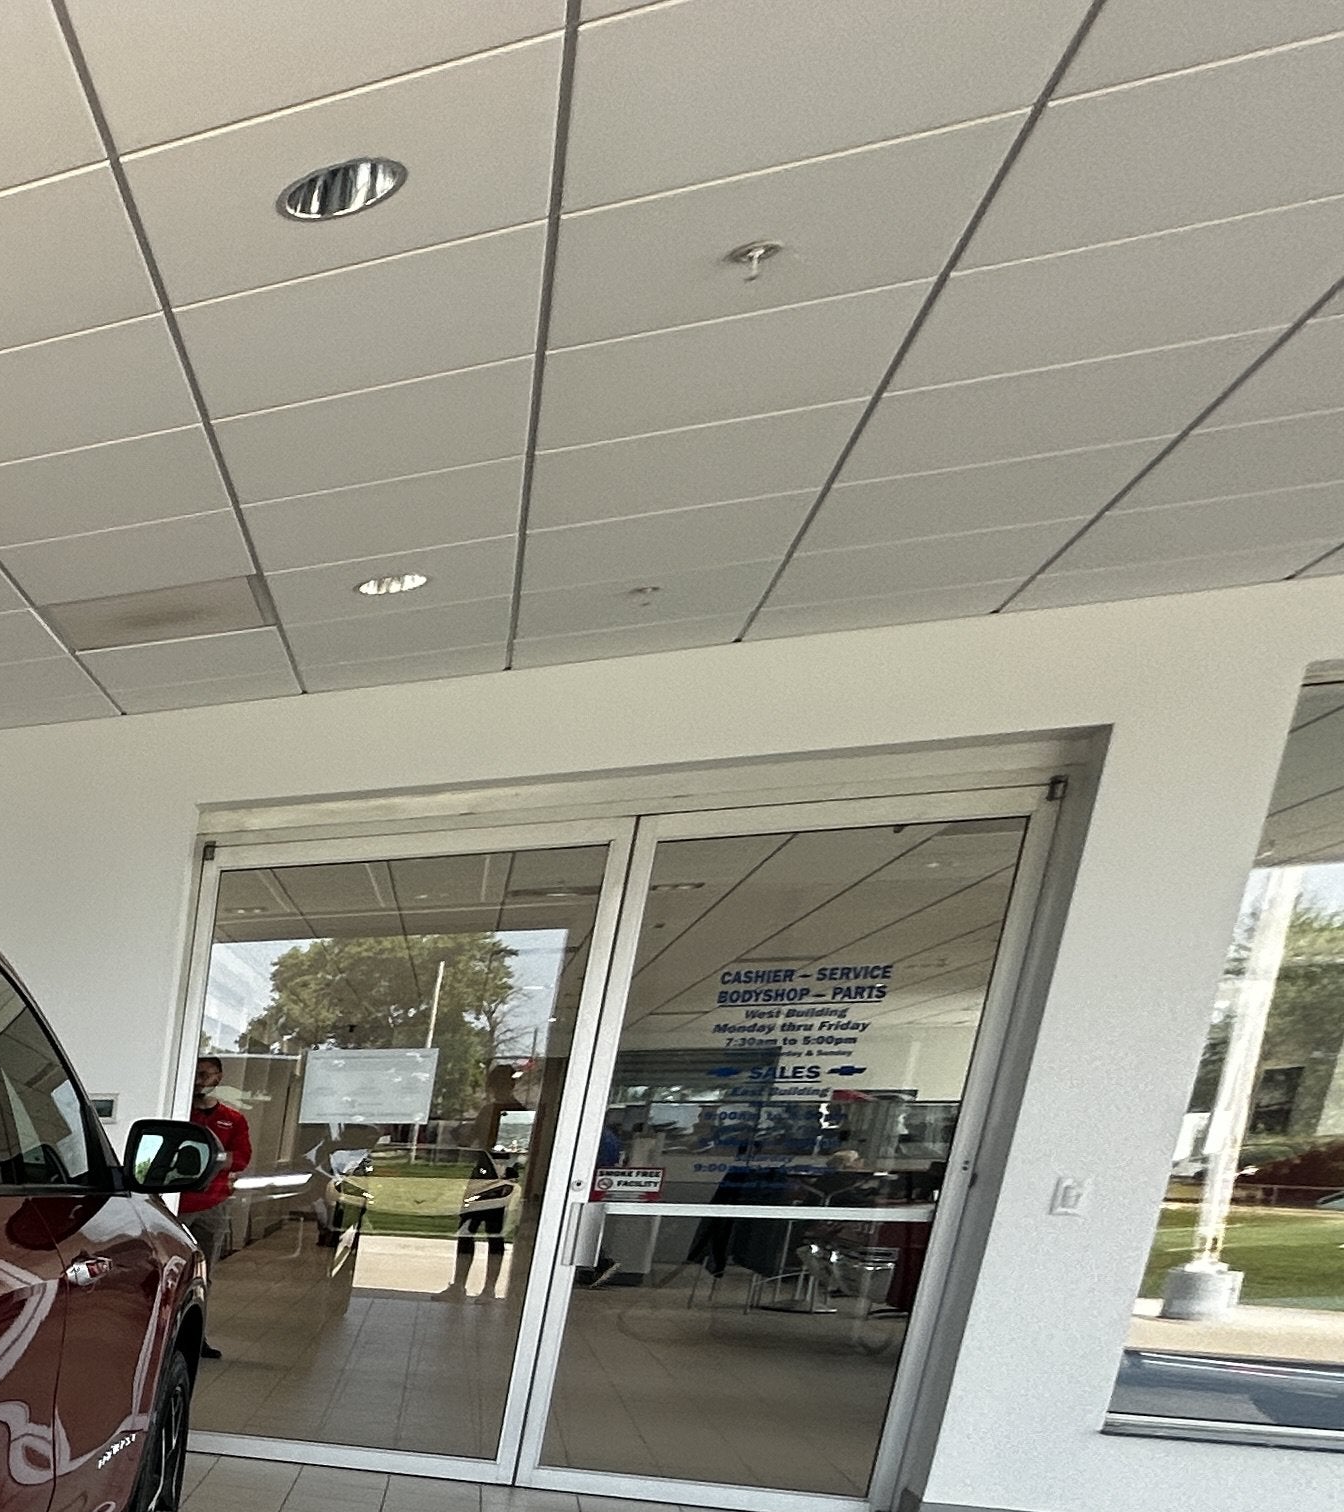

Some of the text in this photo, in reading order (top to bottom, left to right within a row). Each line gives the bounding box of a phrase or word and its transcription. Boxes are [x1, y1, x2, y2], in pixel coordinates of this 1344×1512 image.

[720, 968, 797, 985] CASHIER
[815, 965, 894, 982] SERVICE
[716, 987, 811, 1004] BODYSHOP
[831, 985, 889, 1000] PARTS
[744, 1007, 851, 1020] West Building
[712, 1020, 872, 1036] Monday thru Friday
[725, 1035, 858, 1048] 7:30am to 5:00pm
[748, 1065, 822, 1080] SALES
[635, 1170, 661, 1178] FREE
[616, 1180, 660, 1188] FACILITY
